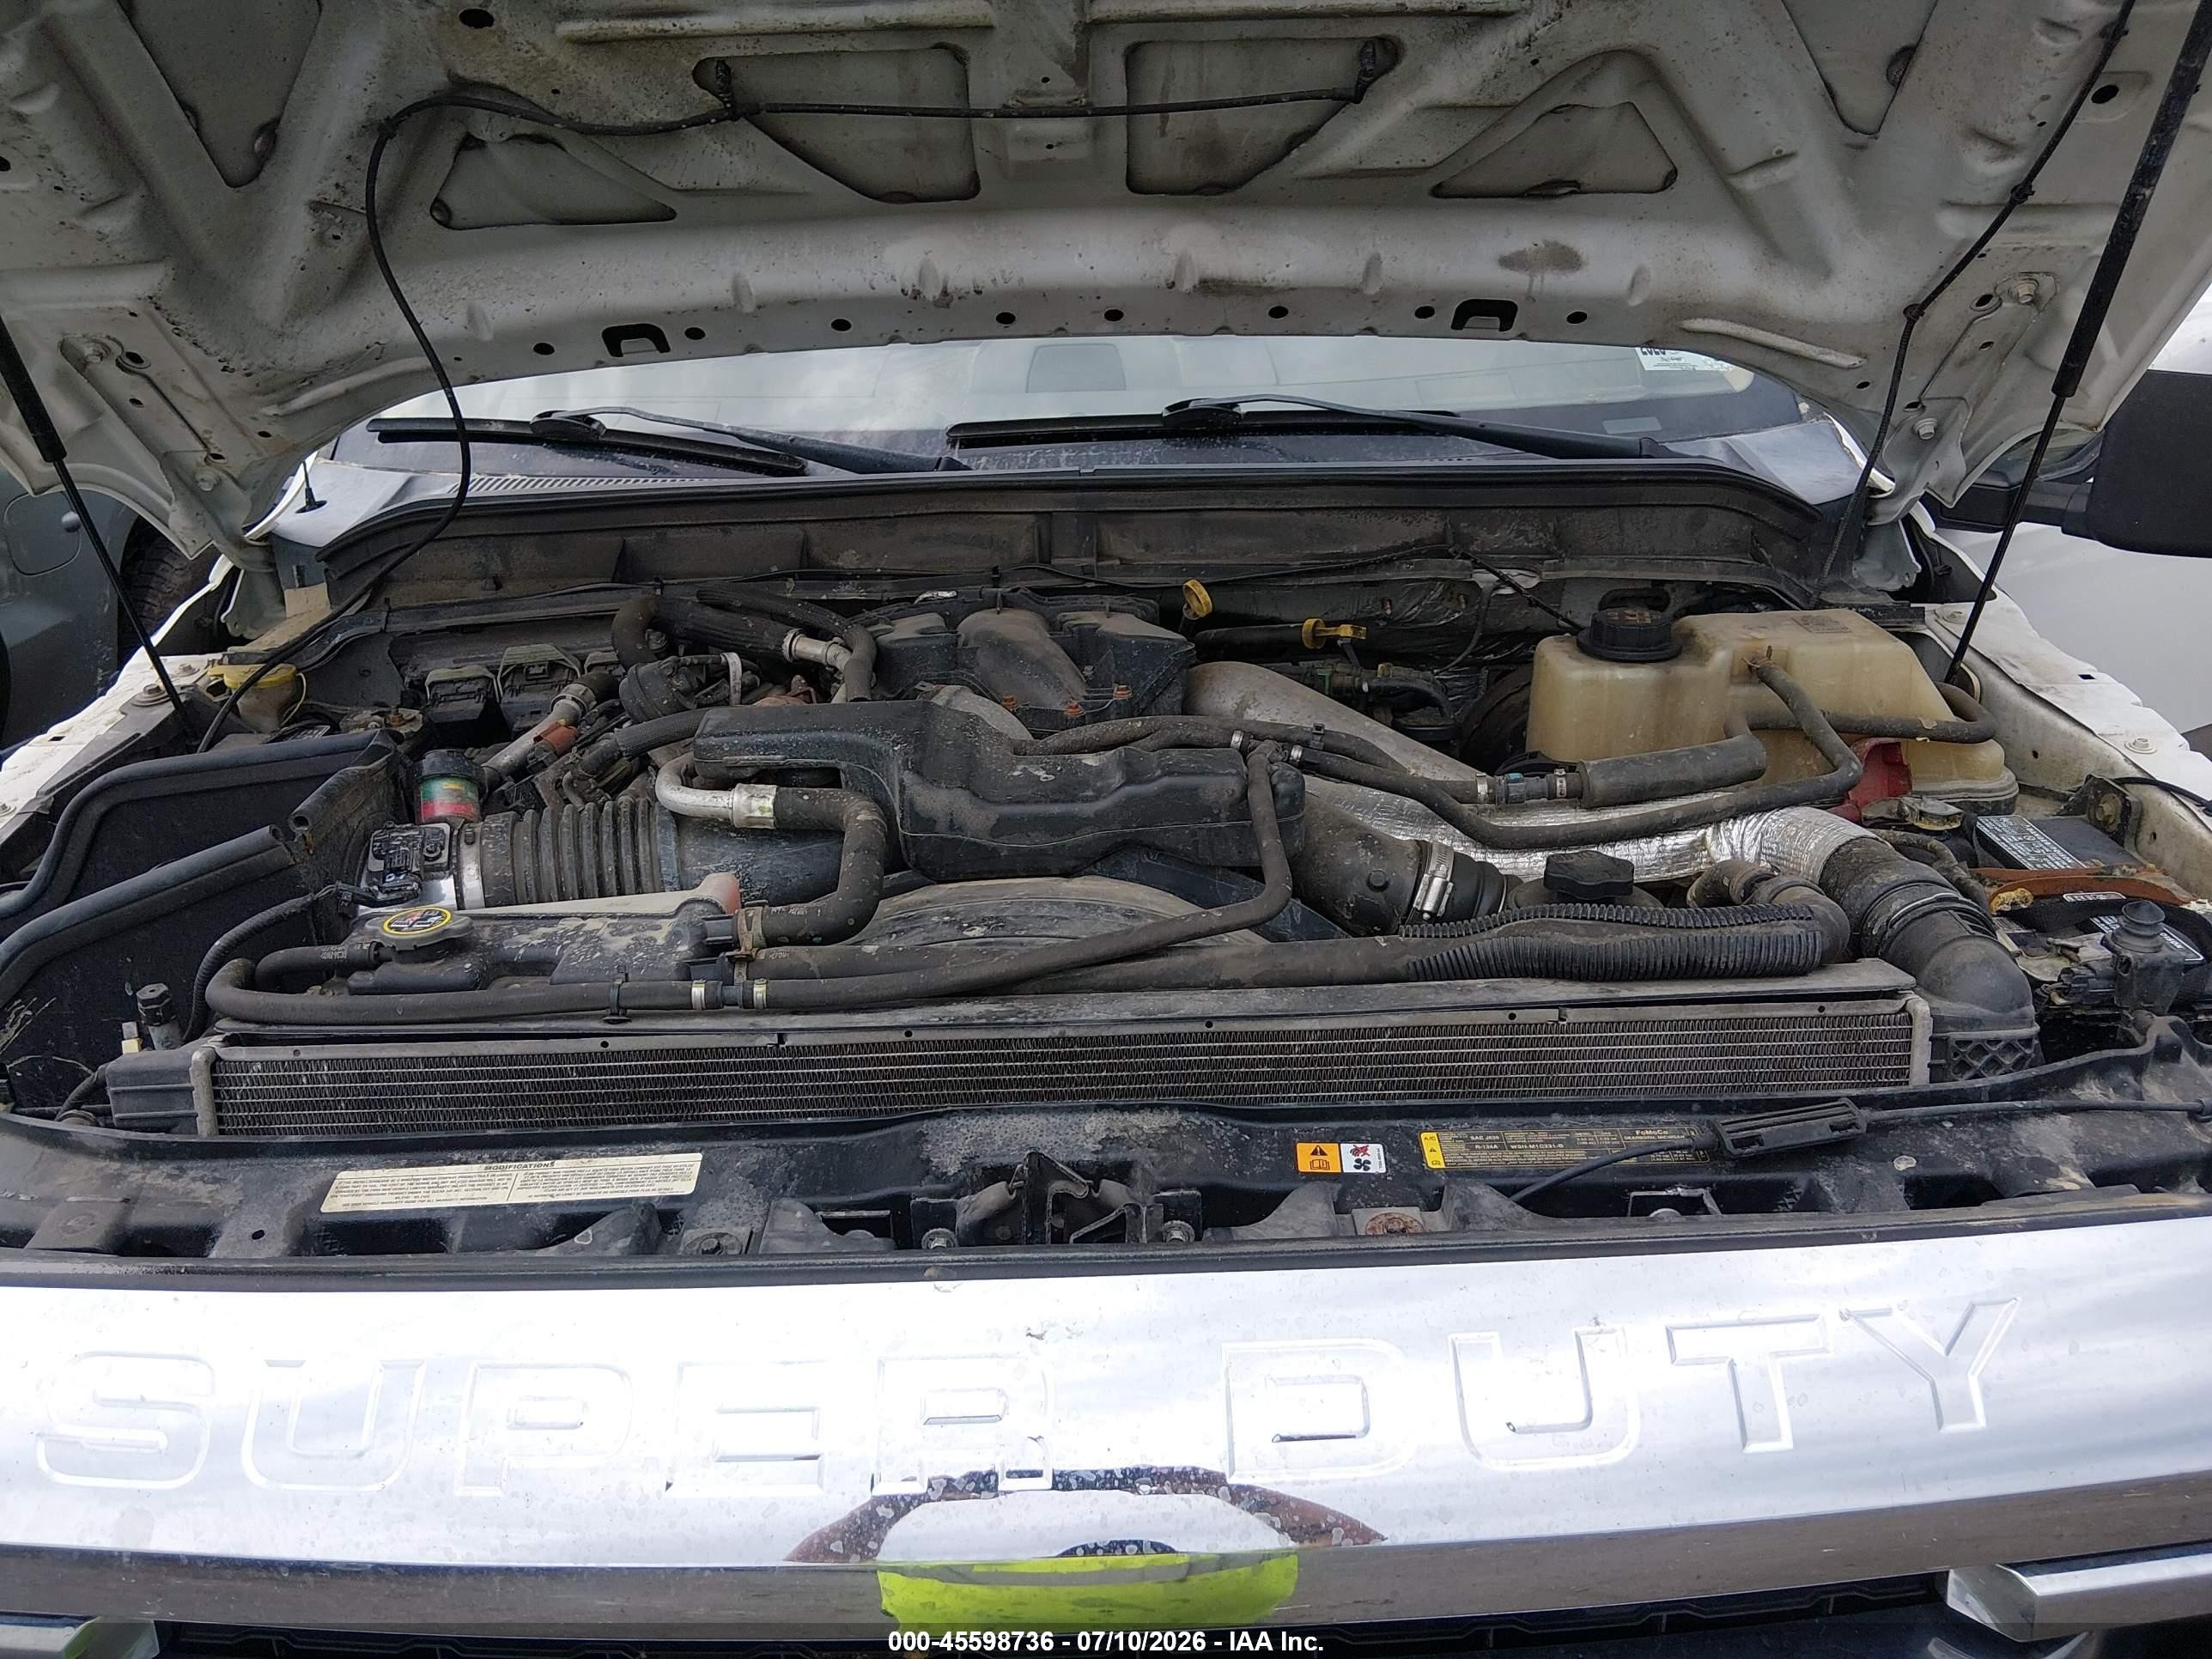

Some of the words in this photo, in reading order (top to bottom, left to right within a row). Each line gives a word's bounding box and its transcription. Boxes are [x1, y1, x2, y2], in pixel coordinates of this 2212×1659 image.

[483, 1161, 556, 1170] MODIFICATIONS
[35, 1351, 1054, 1498] SUPER
[1219, 1296, 2021, 1485] DUTY
